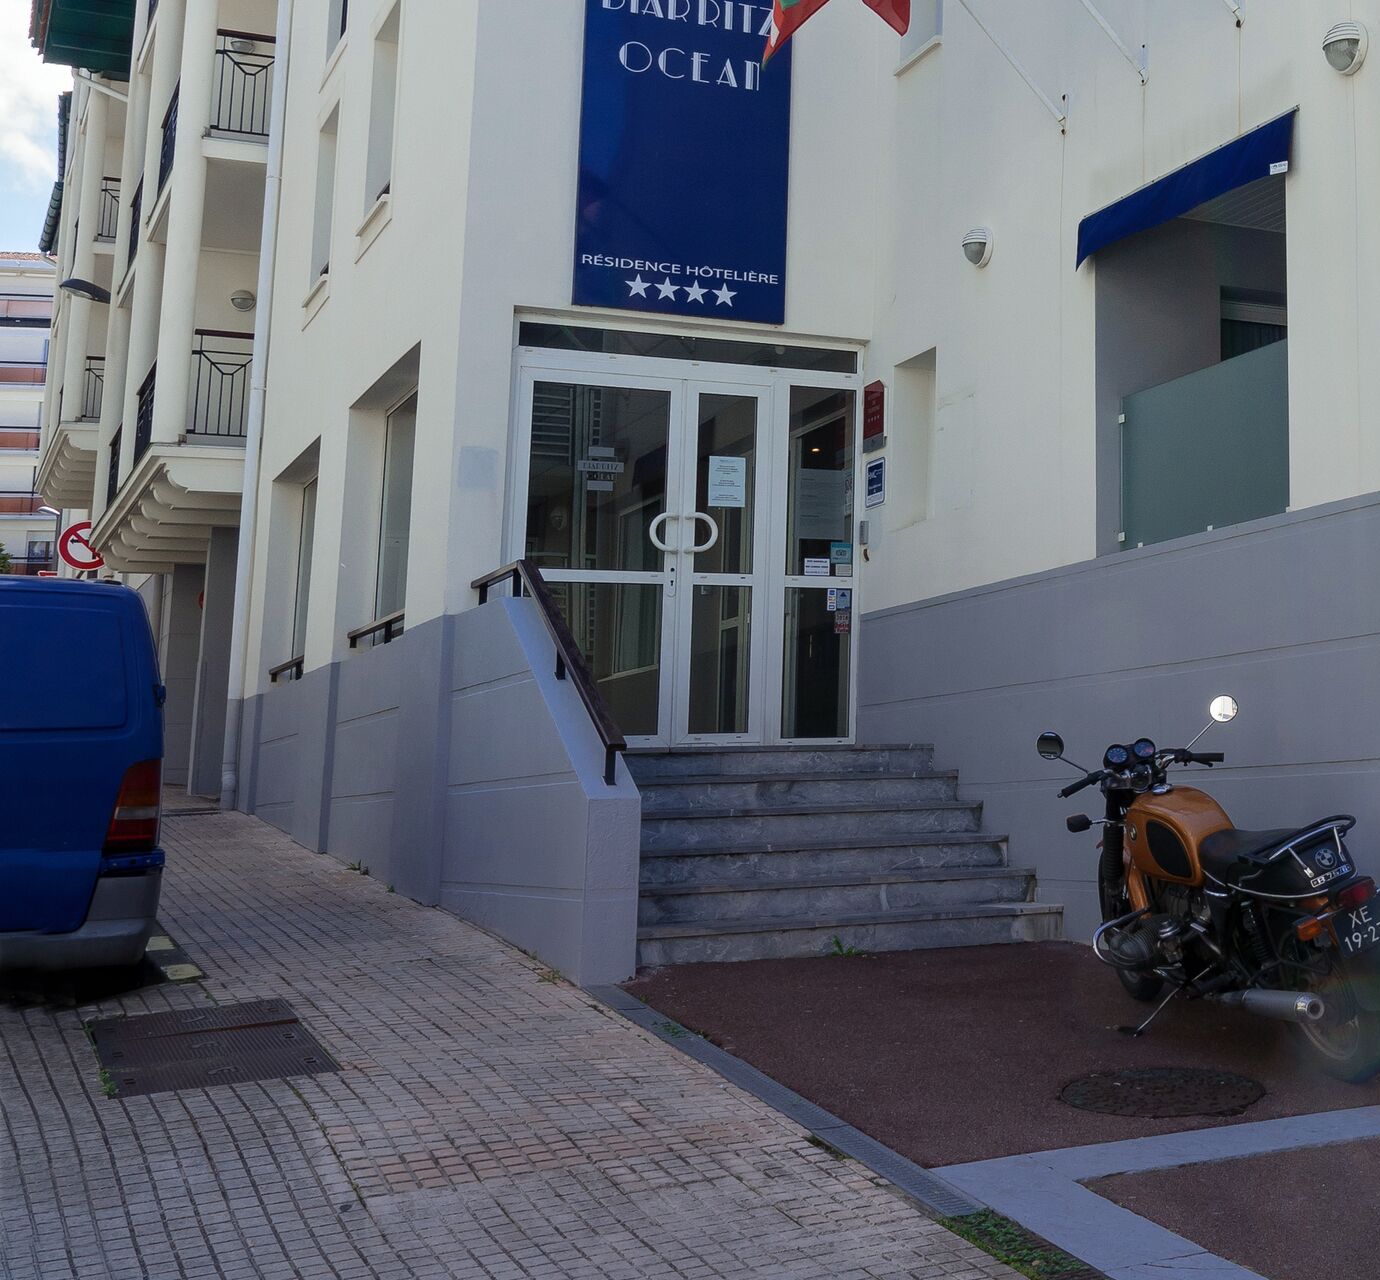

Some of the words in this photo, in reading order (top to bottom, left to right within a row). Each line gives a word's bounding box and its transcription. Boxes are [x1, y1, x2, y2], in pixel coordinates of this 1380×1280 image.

[619, 41, 760, 91] OCEAN
[581, 253, 682, 275] RÉSIDENCE
[685, 265, 780, 285] HÔTELIÈRE
[1348, 905, 1373, 929] XE
